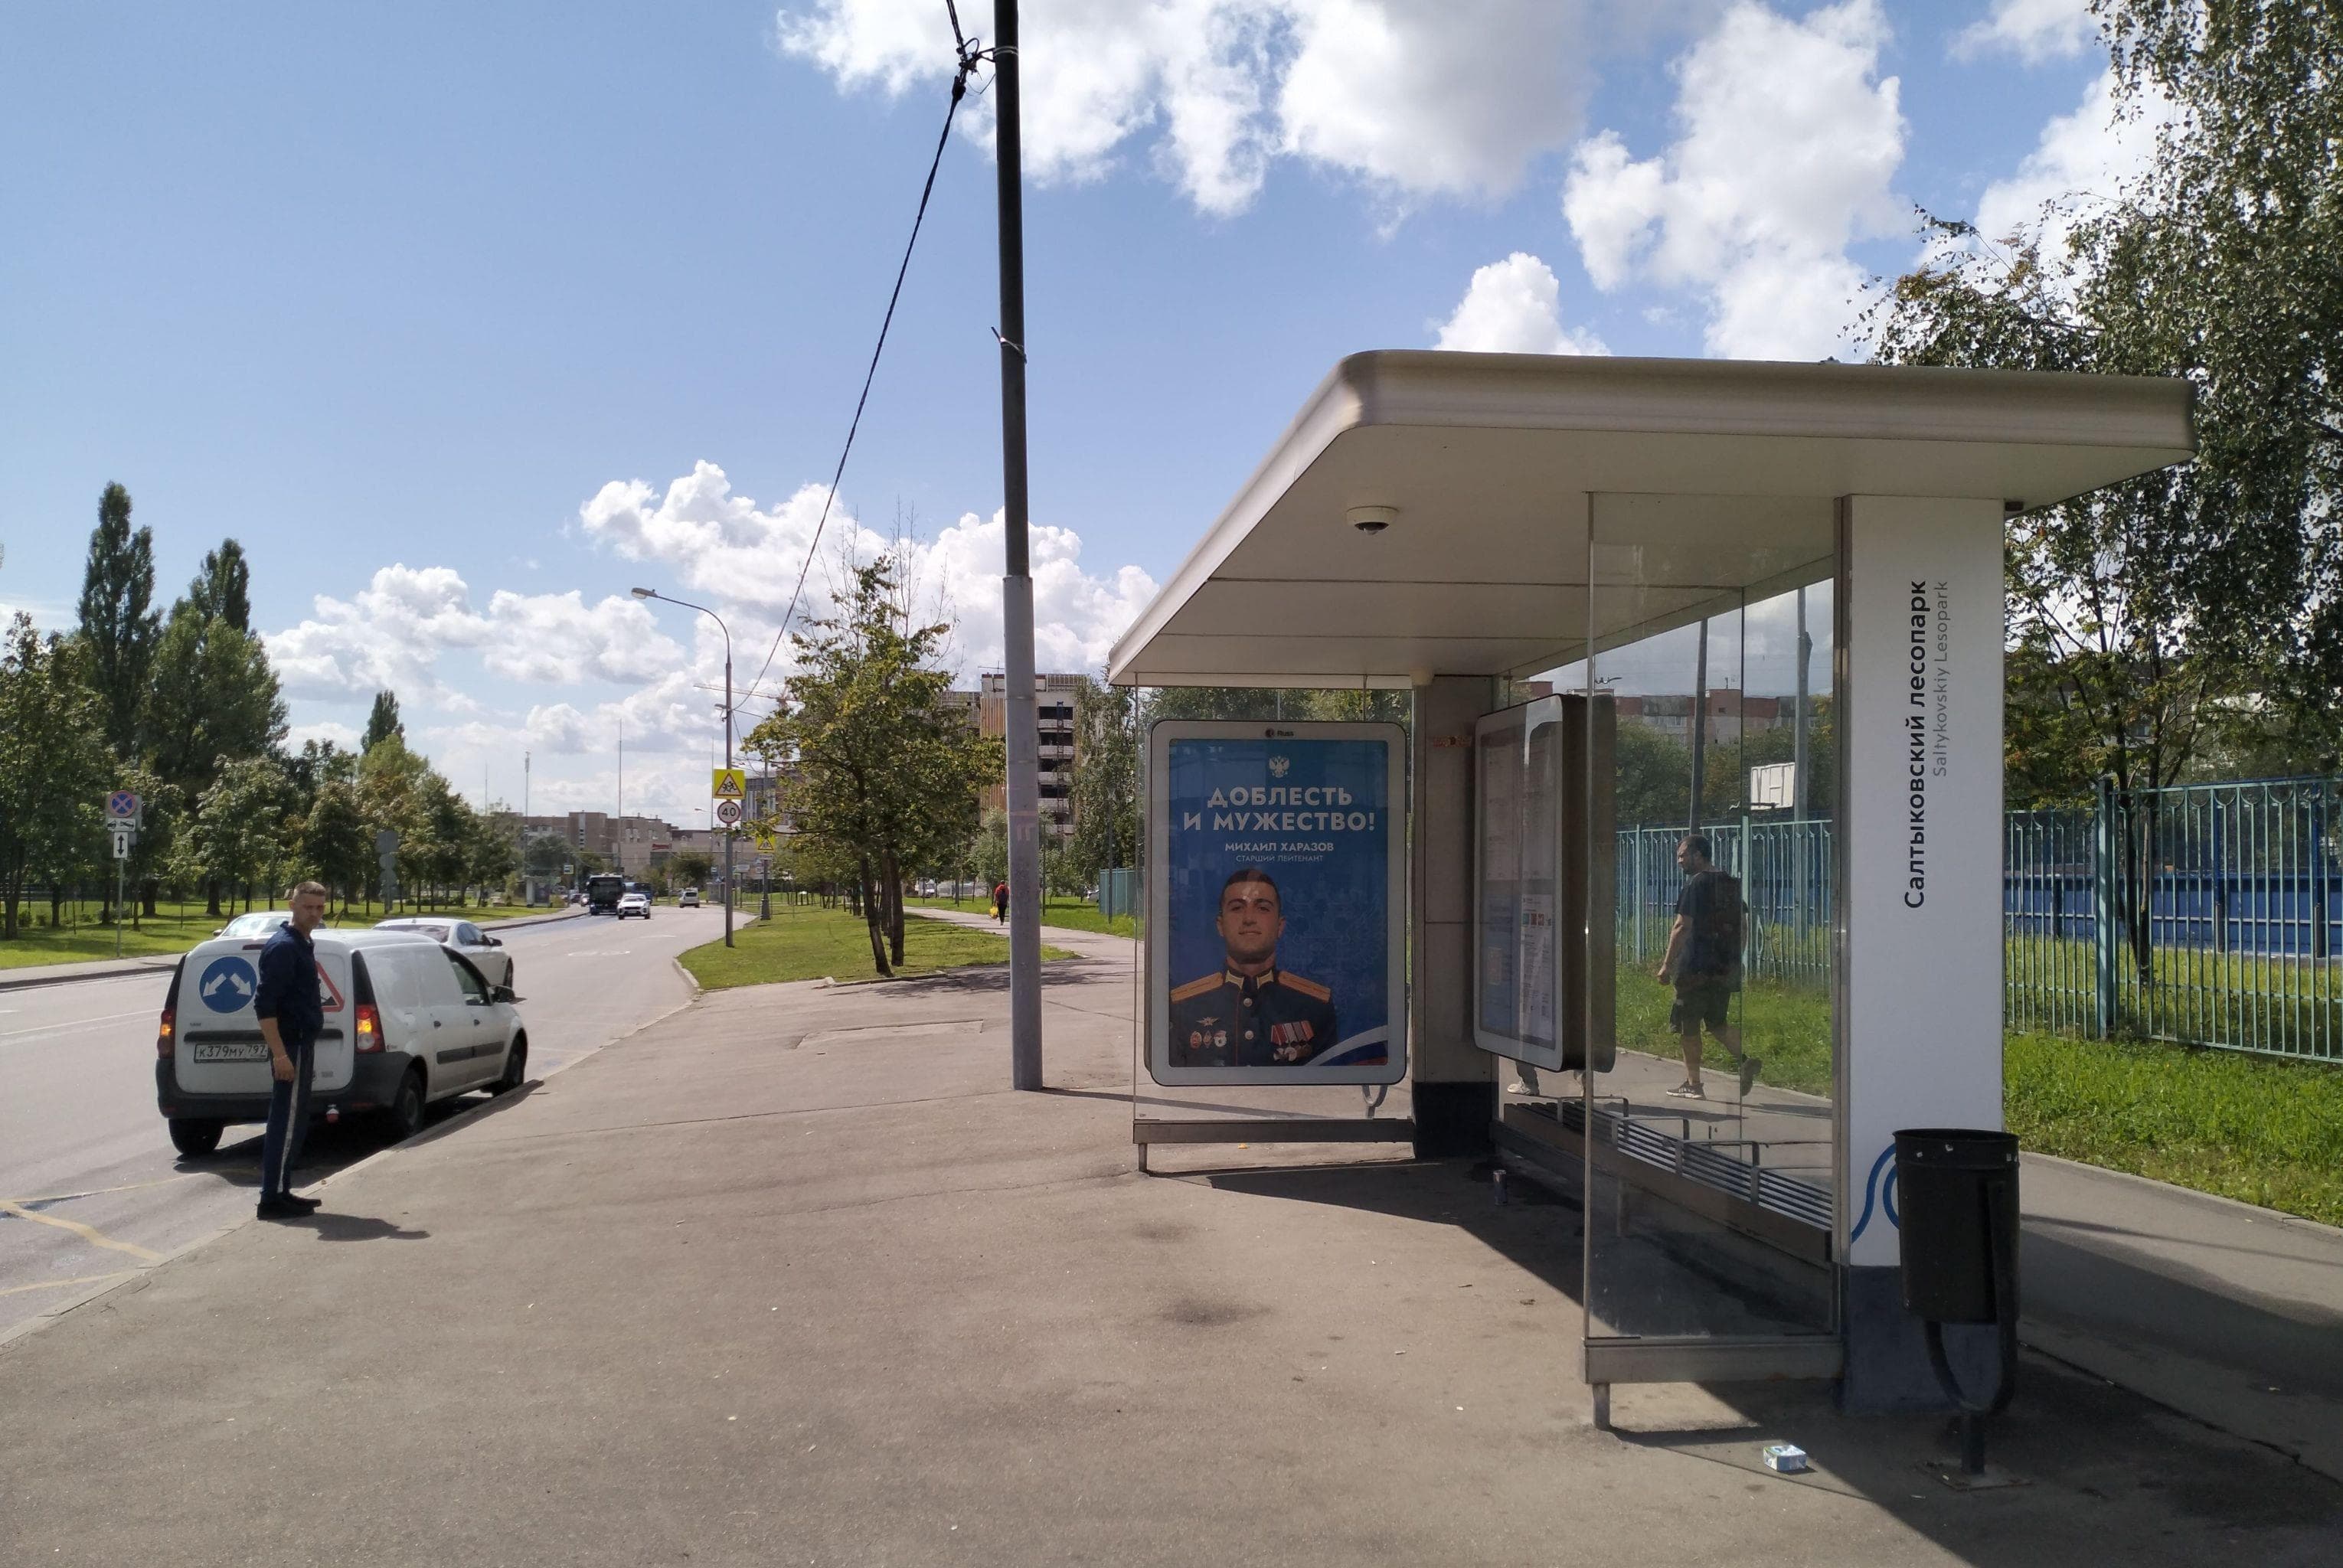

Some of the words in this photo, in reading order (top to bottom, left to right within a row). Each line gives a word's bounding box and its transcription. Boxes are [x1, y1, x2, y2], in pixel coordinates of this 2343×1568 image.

[1910, 580, 1931, 707] лесопарк
[1933, 581, 1951, 662] Lesopark
[1933, 668, 1951, 777] Saltykovskiy
[722, 807, 737, 816] 40
[1184, 812, 1201, 831] И
[1213, 812, 1375, 831] МУЖЕСТВО!
[1207, 787, 1352, 808] ДОБЛЕСТЬ
[1904, 716, 1925, 908] Салтыковский
[1225, 842, 1276, 852] МИХАИЛ
[1280, 842, 1335, 852] ХАРАЗОВ
